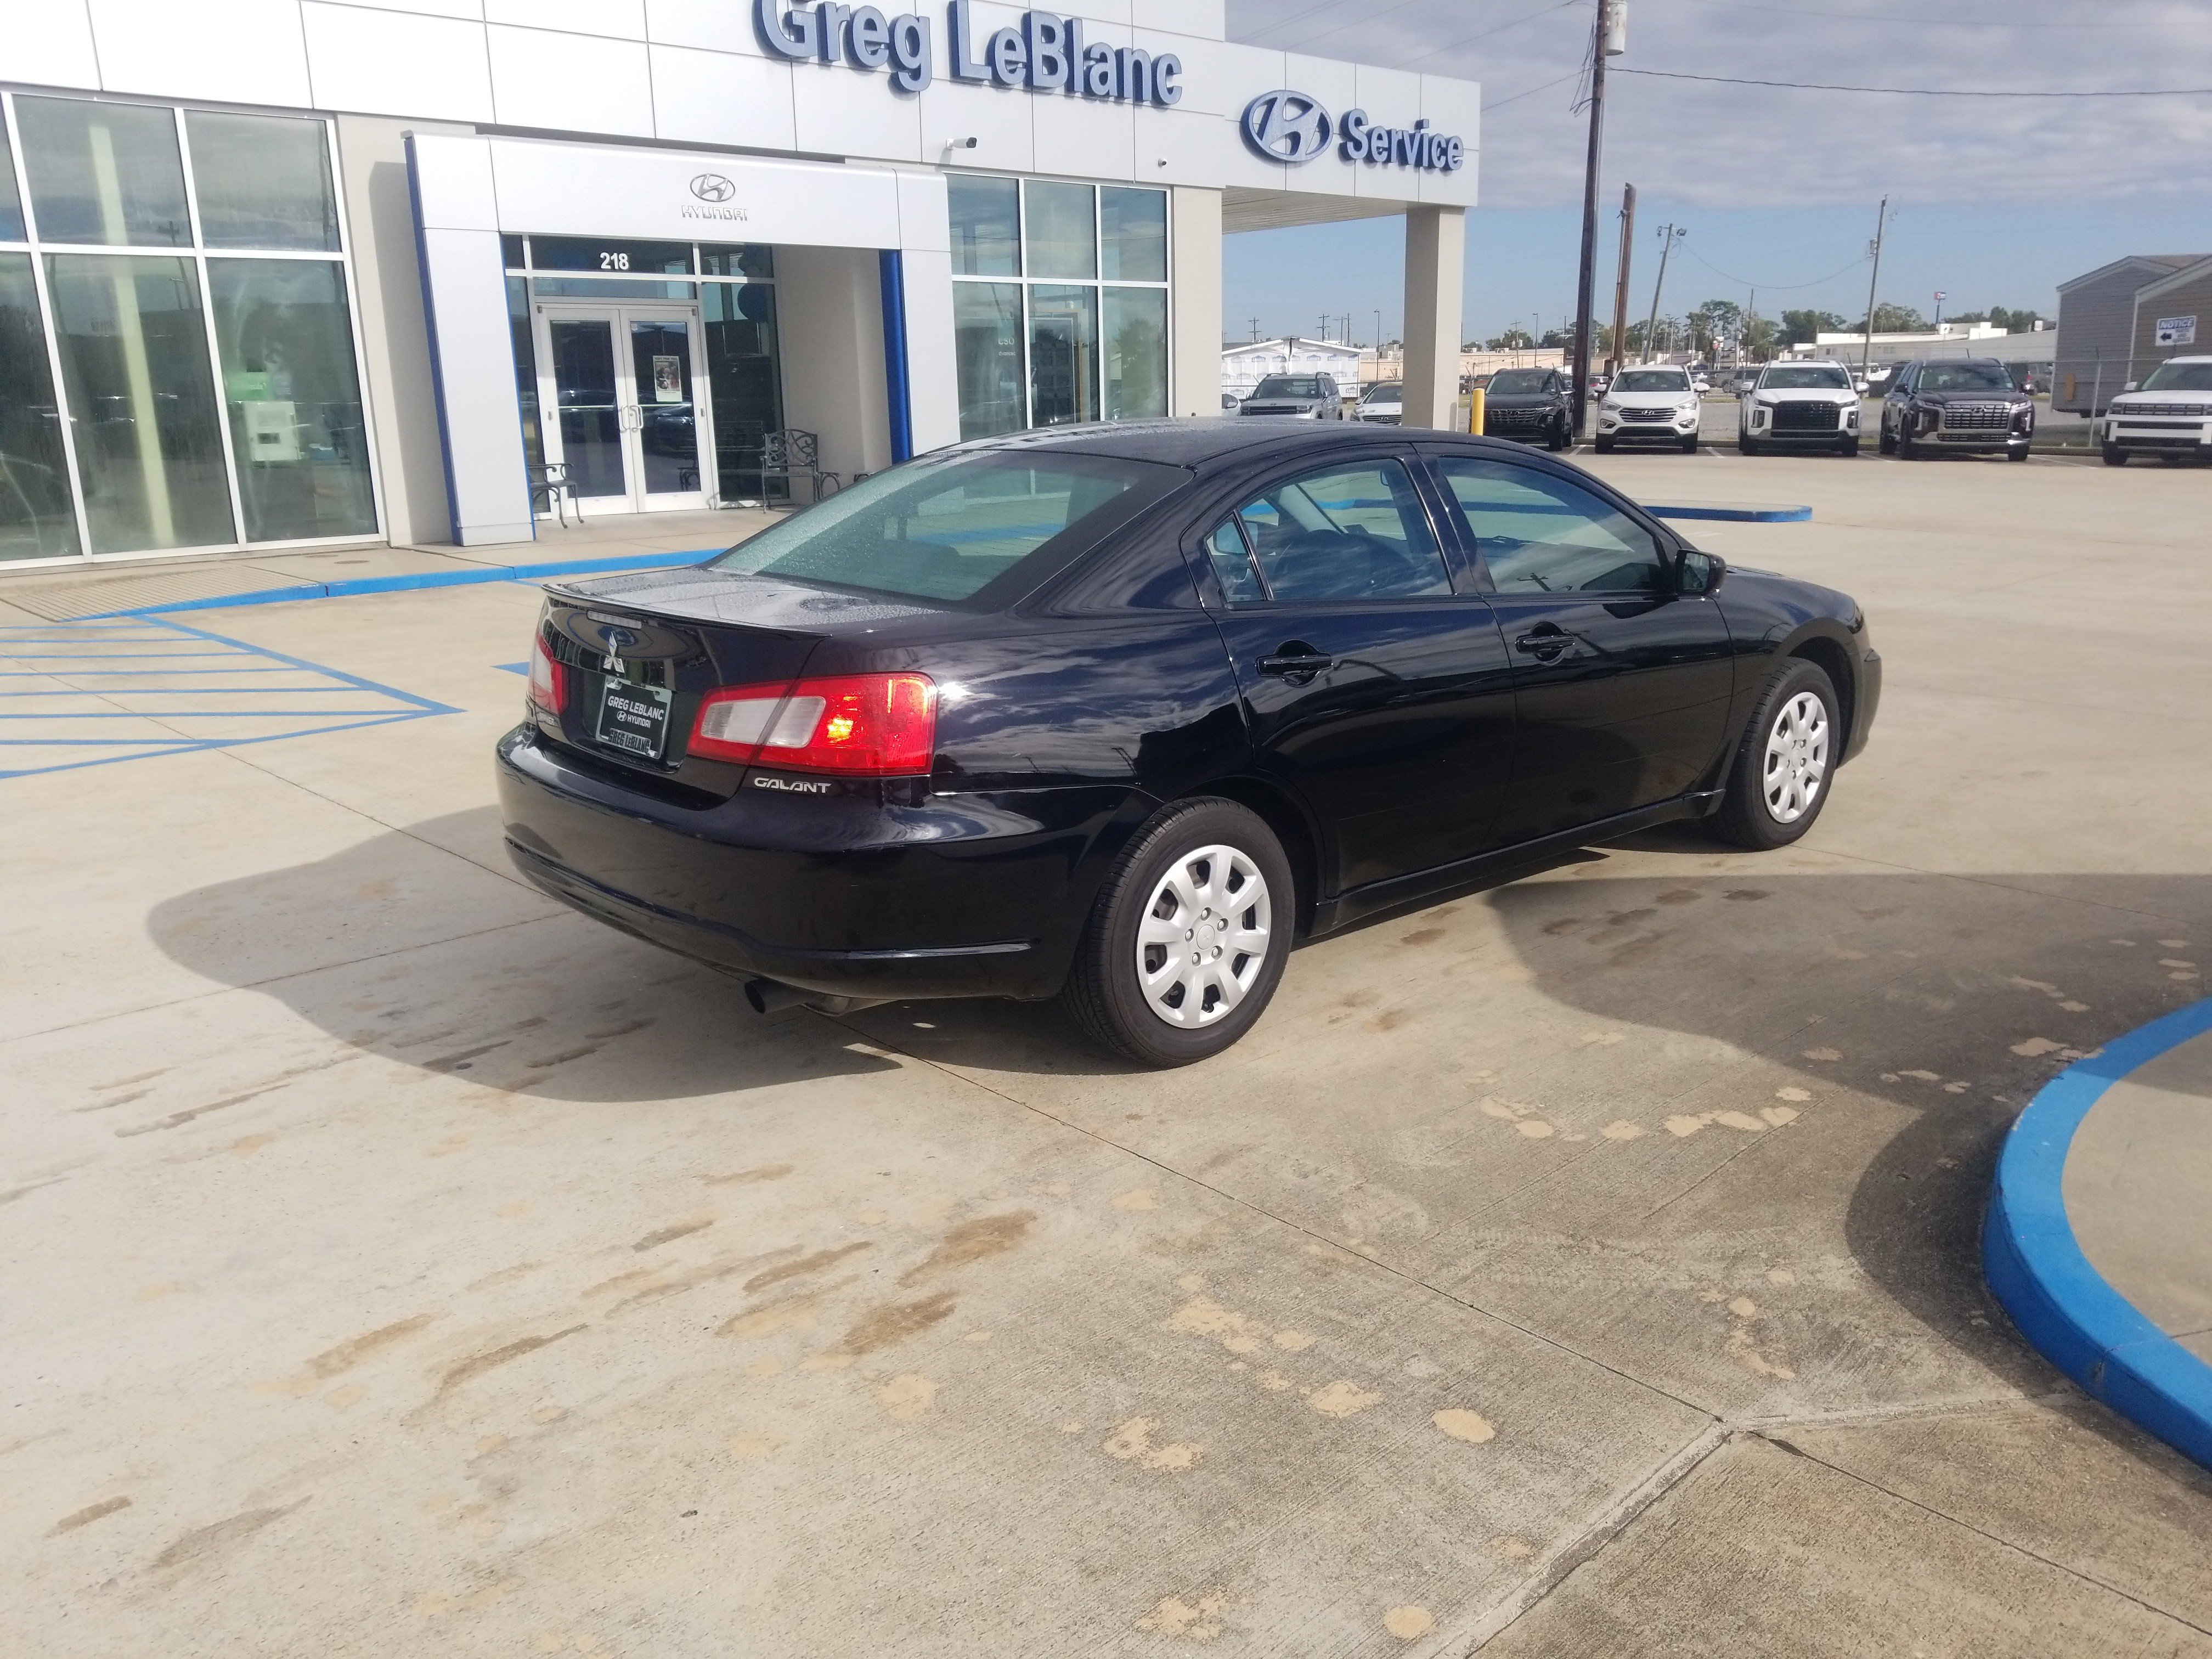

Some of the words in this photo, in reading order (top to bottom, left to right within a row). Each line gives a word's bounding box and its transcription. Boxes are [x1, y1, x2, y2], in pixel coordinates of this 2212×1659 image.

[752, 0, 932, 92] Greg
[946, 0, 1182, 105] LeBlanc
[1340, 109, 1464, 171] Service
[681, 205, 748, 221] HYUNDAI
[600, 252, 629, 270] 218
[608, 696, 629, 710] GREG
[629, 701, 664, 720] LEBLANC
[627, 714, 651, 729] HYUNDAI
[754, 777, 832, 793] GALANT
